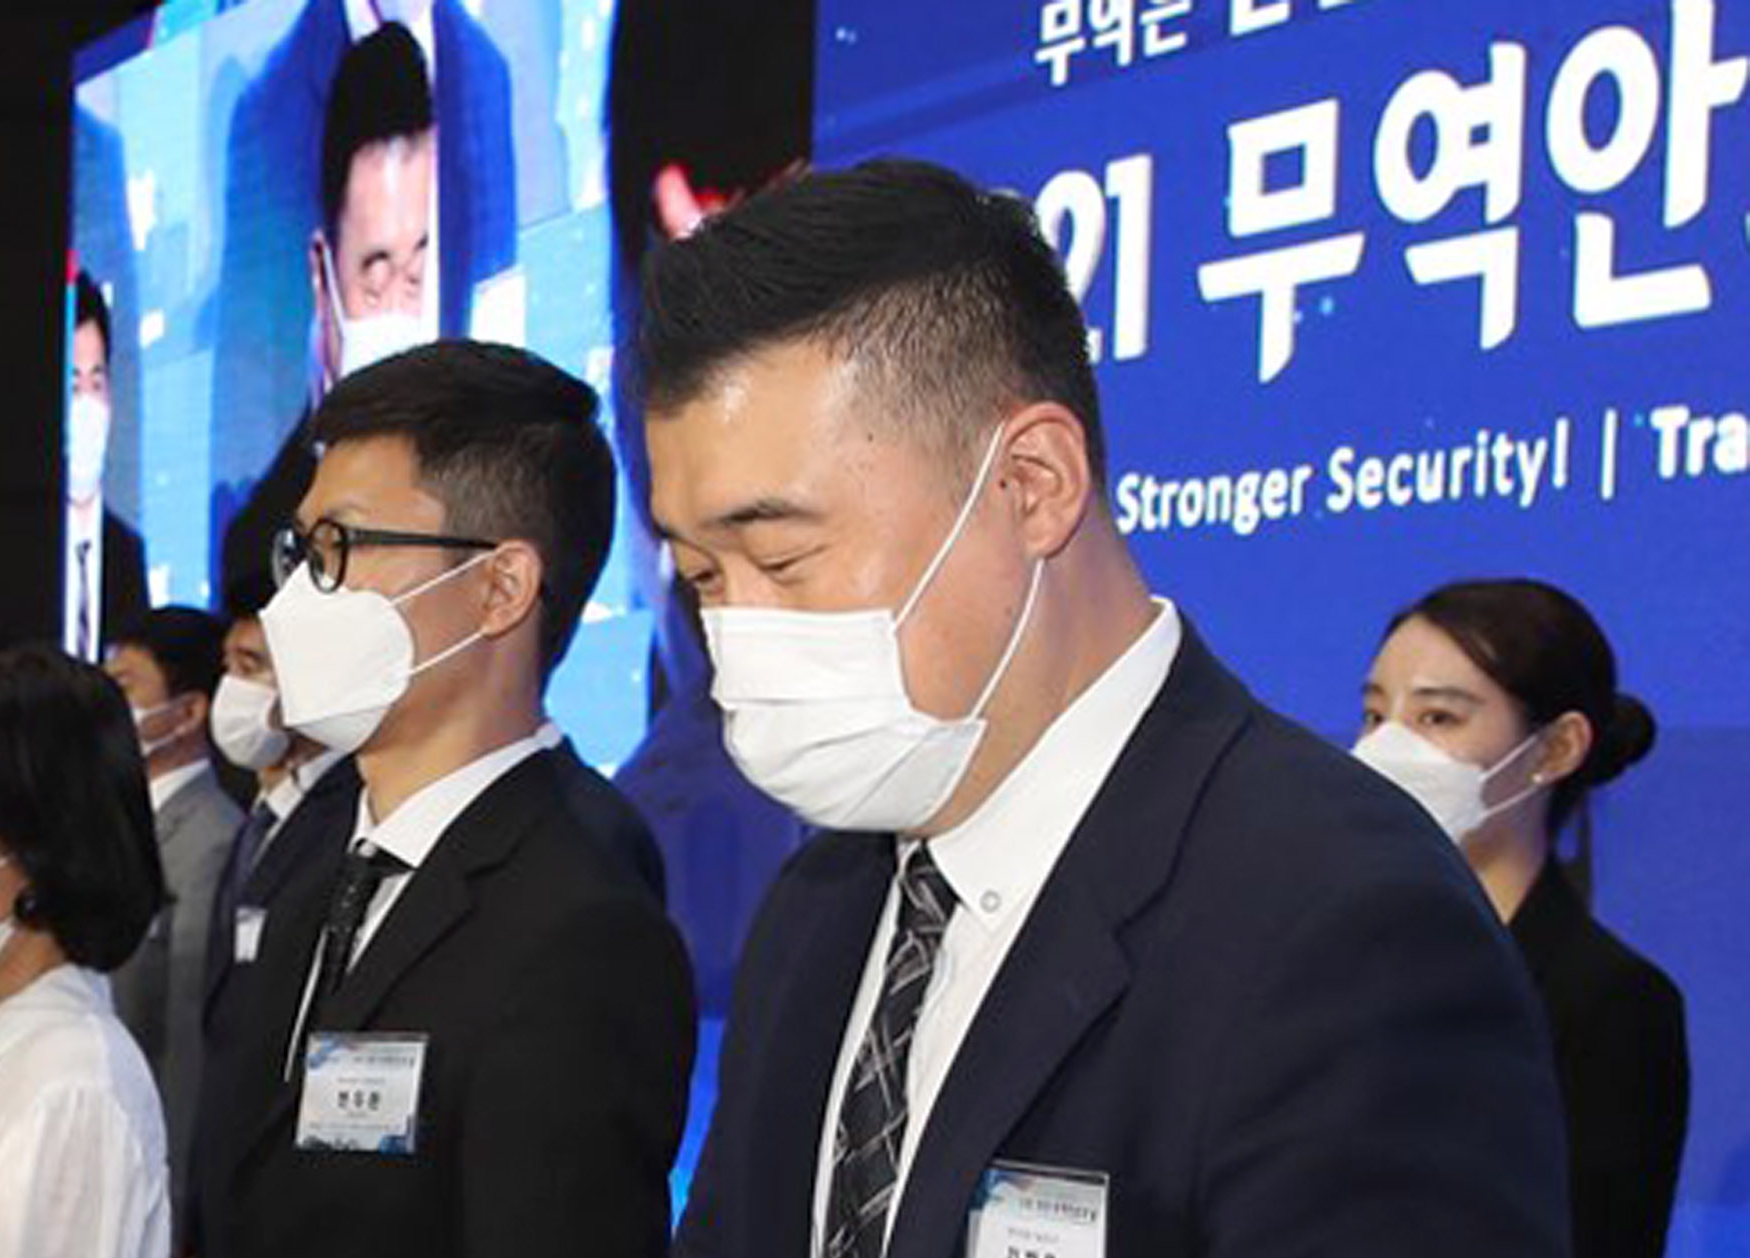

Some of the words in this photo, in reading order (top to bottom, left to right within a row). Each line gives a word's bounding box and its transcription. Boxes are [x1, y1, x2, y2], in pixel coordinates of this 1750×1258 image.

[990, 154, 1153, 363] 21
[1198, 0, 1750, 383] 무역안
[1114, 465, 1313, 536] Stronger
